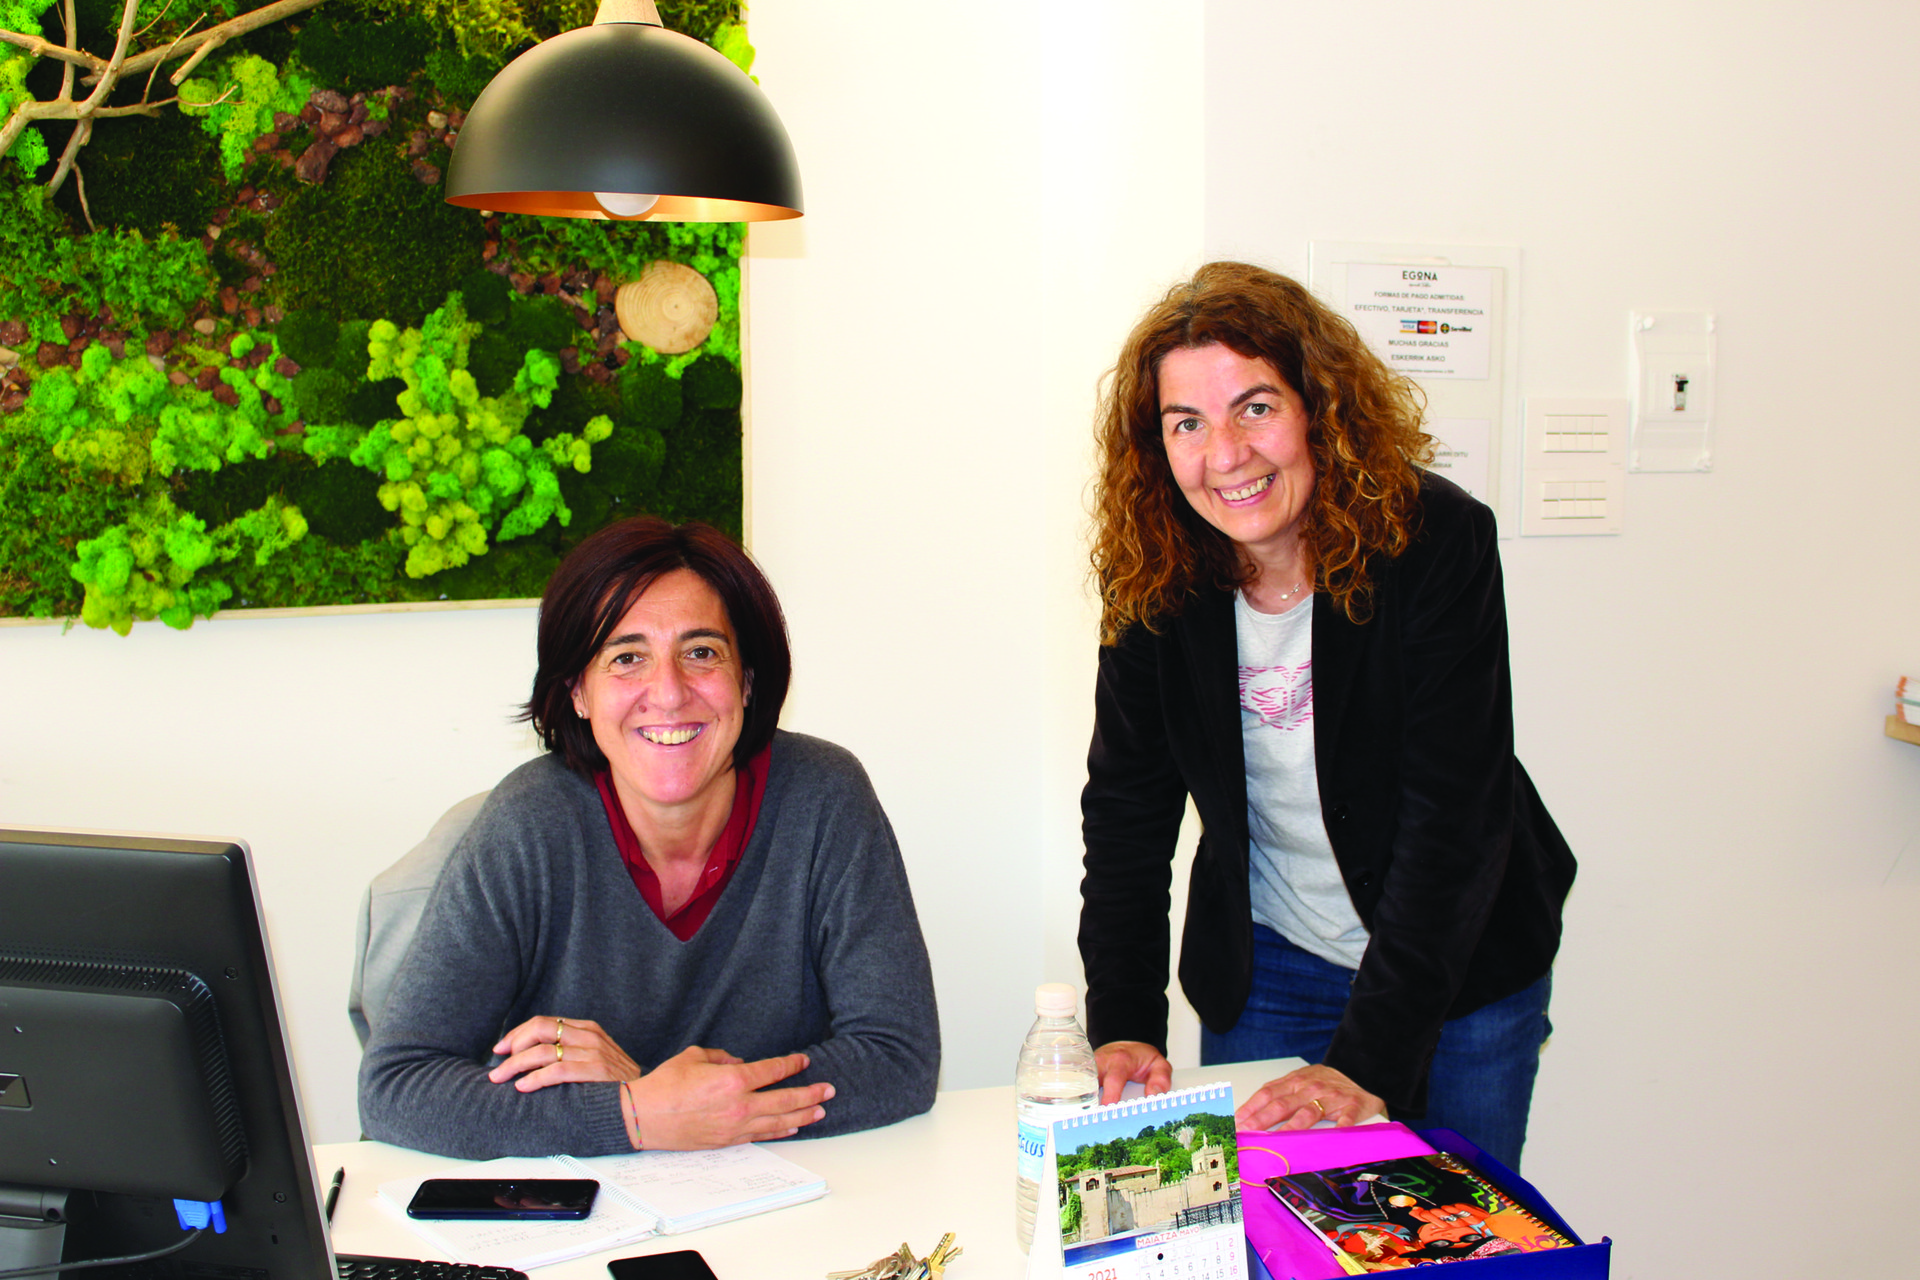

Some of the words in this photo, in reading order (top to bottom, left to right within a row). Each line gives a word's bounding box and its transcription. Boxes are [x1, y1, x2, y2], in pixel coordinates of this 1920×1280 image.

[1402, 270, 1438, 280] EGONA
[1411, 292, 1429, 300] PAGO
[1428, 307, 1483, 315] TRANSFERENCIA
[1388, 339, 1417, 347] MUCHAS
[1418, 340, 1449, 348] GRACIAS
[1018, 1133, 1046, 1157] ALUS
[1137, 1231, 1177, 1247] MAIATZA
[1179, 1226, 1200, 1237] MAYO
[1228, 1237, 1234, 1248] 2
[1160, 1269, 1165, 1278] 4
[1174, 1265, 1179, 1275] 5
[1188, 1261, 1193, 1272] 6
[1202, 1258, 1207, 1268] 7
[1216, 1254, 1221, 1265] 8
[1229, 1251, 1235, 1262] 9
[1088, 1268, 1118, 1280] 2021
[1216, 1268, 1224, 1280] 15
[1229, 1264, 1238, 1276] 16
